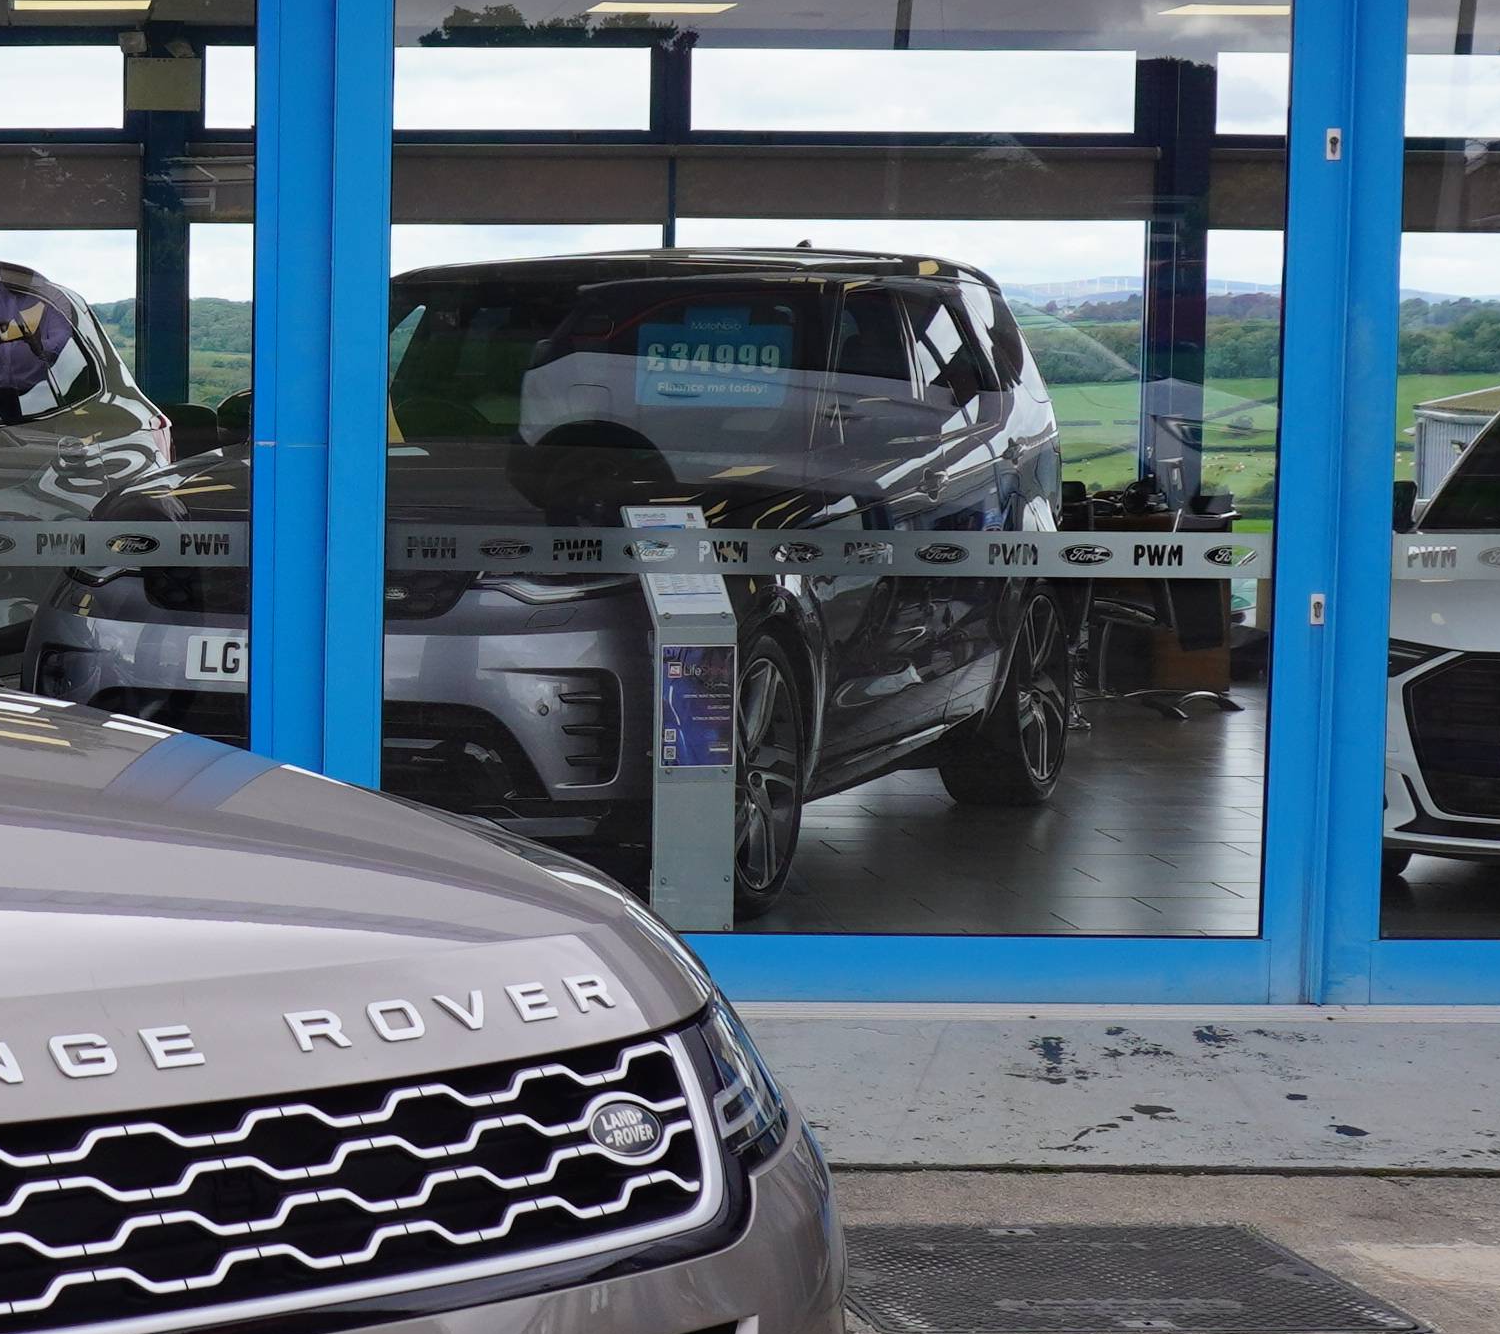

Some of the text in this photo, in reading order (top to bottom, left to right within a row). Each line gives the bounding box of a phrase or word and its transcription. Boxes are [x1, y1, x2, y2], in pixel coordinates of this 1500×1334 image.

[646, 342, 781, 375] £34999
[657, 381, 769, 396] Finance me today!
[35, 533, 87, 556] PWM
[179, 532, 230, 555] PWM
[406, 536, 457, 560] PWM
[484, 540, 529, 558] Ford
[552, 538, 603, 562] PWM
[698, 539, 749, 564] PWM
[919, 545, 964, 563] Ford
[988, 543, 1039, 566] PWM
[1133, 544, 1184, 566] PWM
[1407, 546, 1457, 568] PWM
[199, 640, 248, 675] LG
[283, 972, 618, 1053] ROVER
[599, 1109, 637, 1131] LAND
[612, 1123, 655, 1148] ROVER
